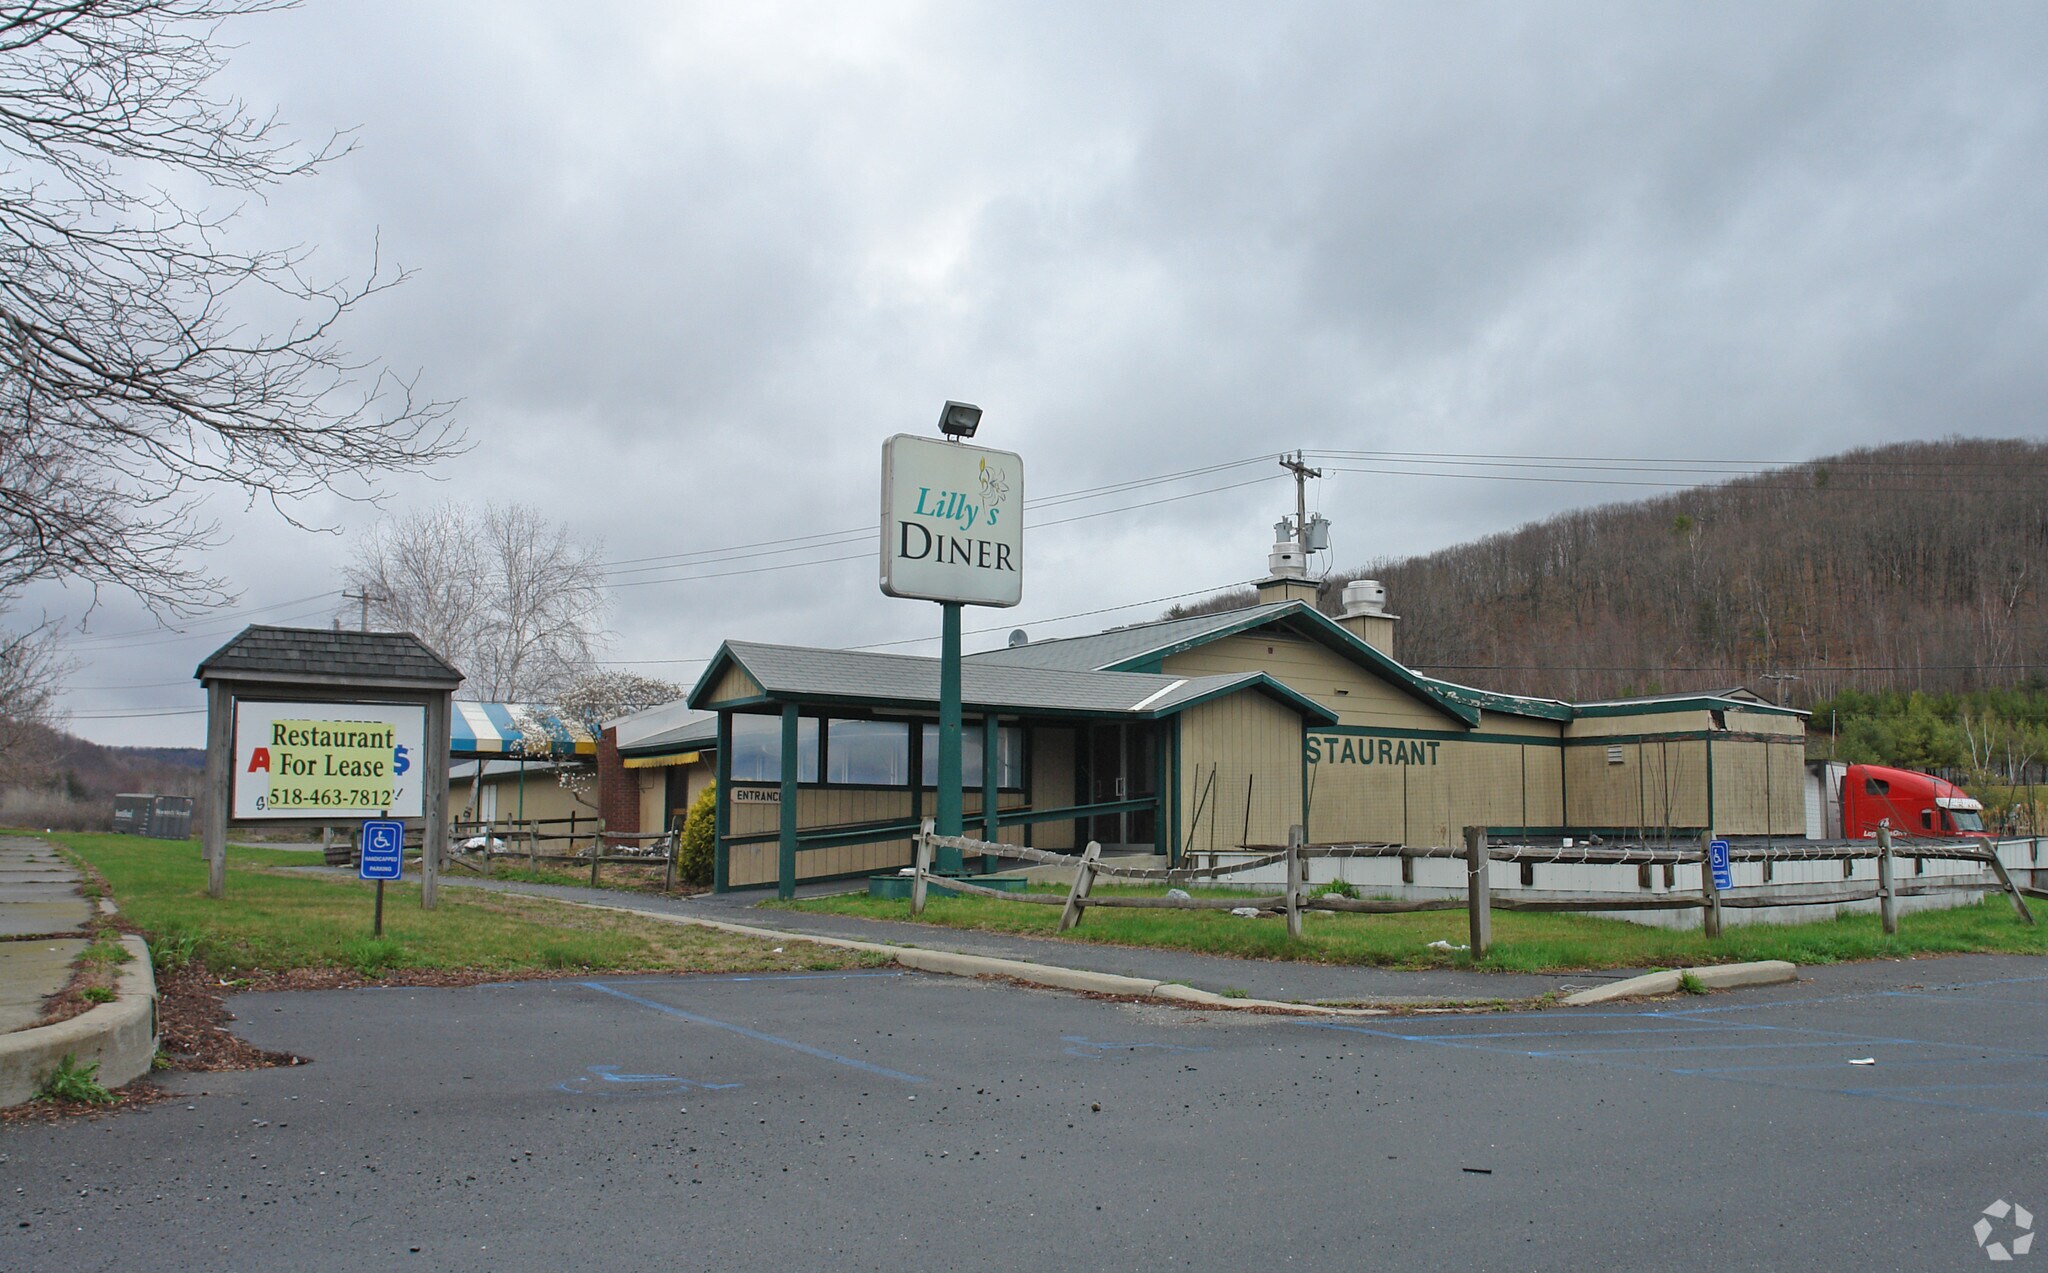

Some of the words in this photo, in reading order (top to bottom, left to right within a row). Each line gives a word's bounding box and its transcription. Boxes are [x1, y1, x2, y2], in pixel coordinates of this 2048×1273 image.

[913, 487, 1000, 531] Lilly's
[271, 723, 394, 749] Restaurant
[279, 753, 317, 776] For
[324, 754, 384, 777] Lease
[269, 788, 391, 806] 518-463-7812
